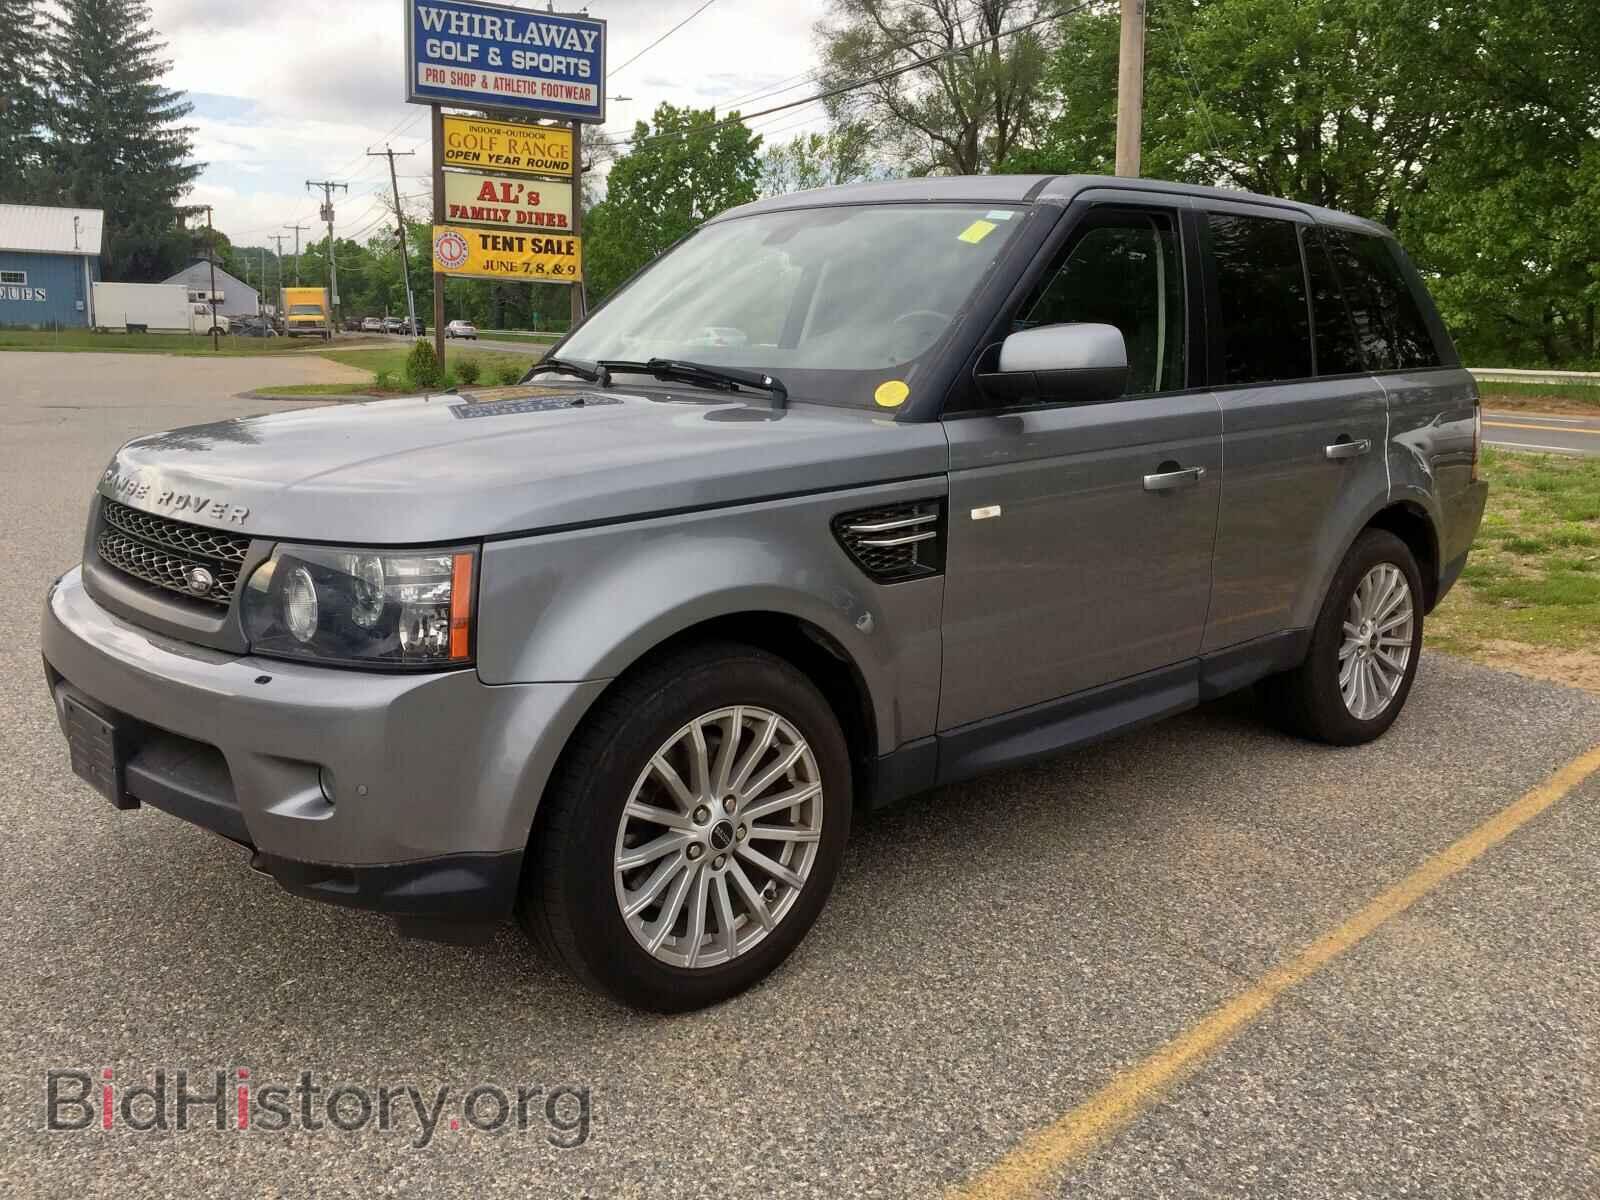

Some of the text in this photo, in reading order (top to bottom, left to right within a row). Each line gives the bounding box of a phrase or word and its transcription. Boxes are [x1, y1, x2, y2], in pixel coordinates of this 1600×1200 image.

[418, 6, 598, 53] WHIRLAWAY
[426, 39, 591, 78] GOLF & SPORTS
[425, 67, 591, 101] PRO SHOP & ATHLETIC FOOTWEAR
[448, 132, 568, 160] GOLF RANGE
[446, 150, 569, 171] OPEN YEAR ROUND
[449, 204, 568, 228] FAMILY DINER
[479, 234, 526, 253] TENT
[531, 237, 575, 256] SALE
[483, 260, 518, 273] JUNE
[157, 490, 251, 526] ROVER
